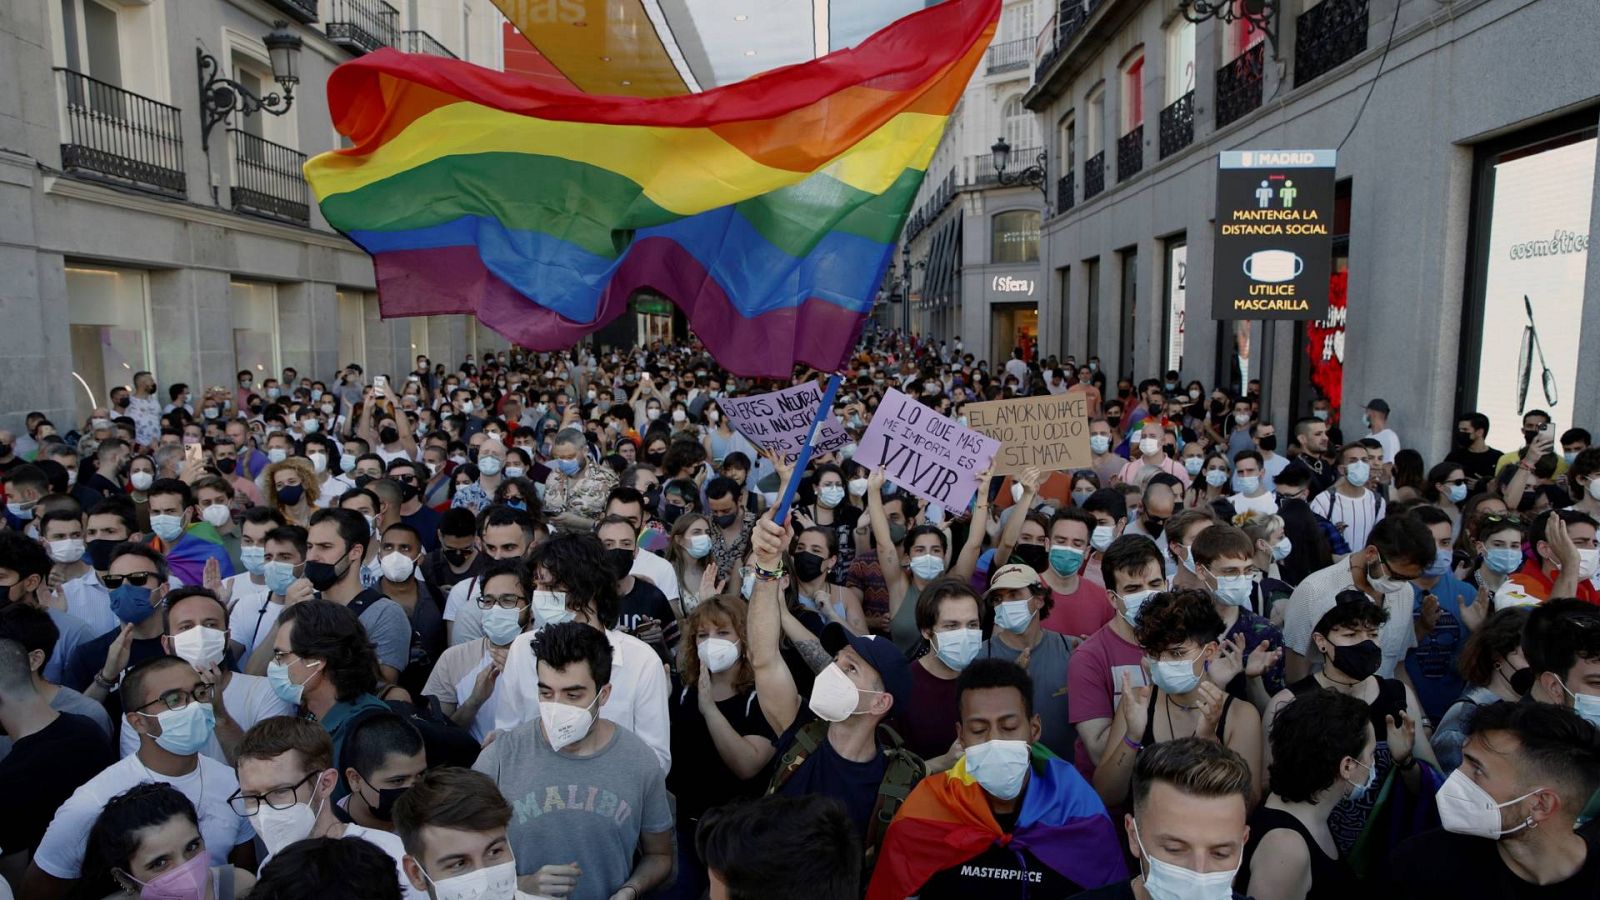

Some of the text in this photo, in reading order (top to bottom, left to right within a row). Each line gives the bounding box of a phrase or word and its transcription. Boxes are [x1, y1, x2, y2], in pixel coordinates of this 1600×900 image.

[1259, 153, 1315, 165] MADRID
[1233, 210, 1318, 220] MANTENGA LA
[1222, 224, 1328, 235] DISTANCIA SOCIAL
[1250, 285, 1295, 295] UTILICE
[1234, 299, 1309, 310] MASCARILLA
[737, 399, 774, 420] ERES
[969, 400, 1085, 427] EL AMOR NO HACE
[821, 427, 839, 438] EL
[897, 401, 983, 454] LO QUE MÁS
[975, 421, 1082, 442] AÑO, TU ODIO
[883, 418, 976, 470] ME IMPORTA ES
[1005, 442, 1072, 466] SÍ MATA
[877, 433, 958, 502] VIVIR
